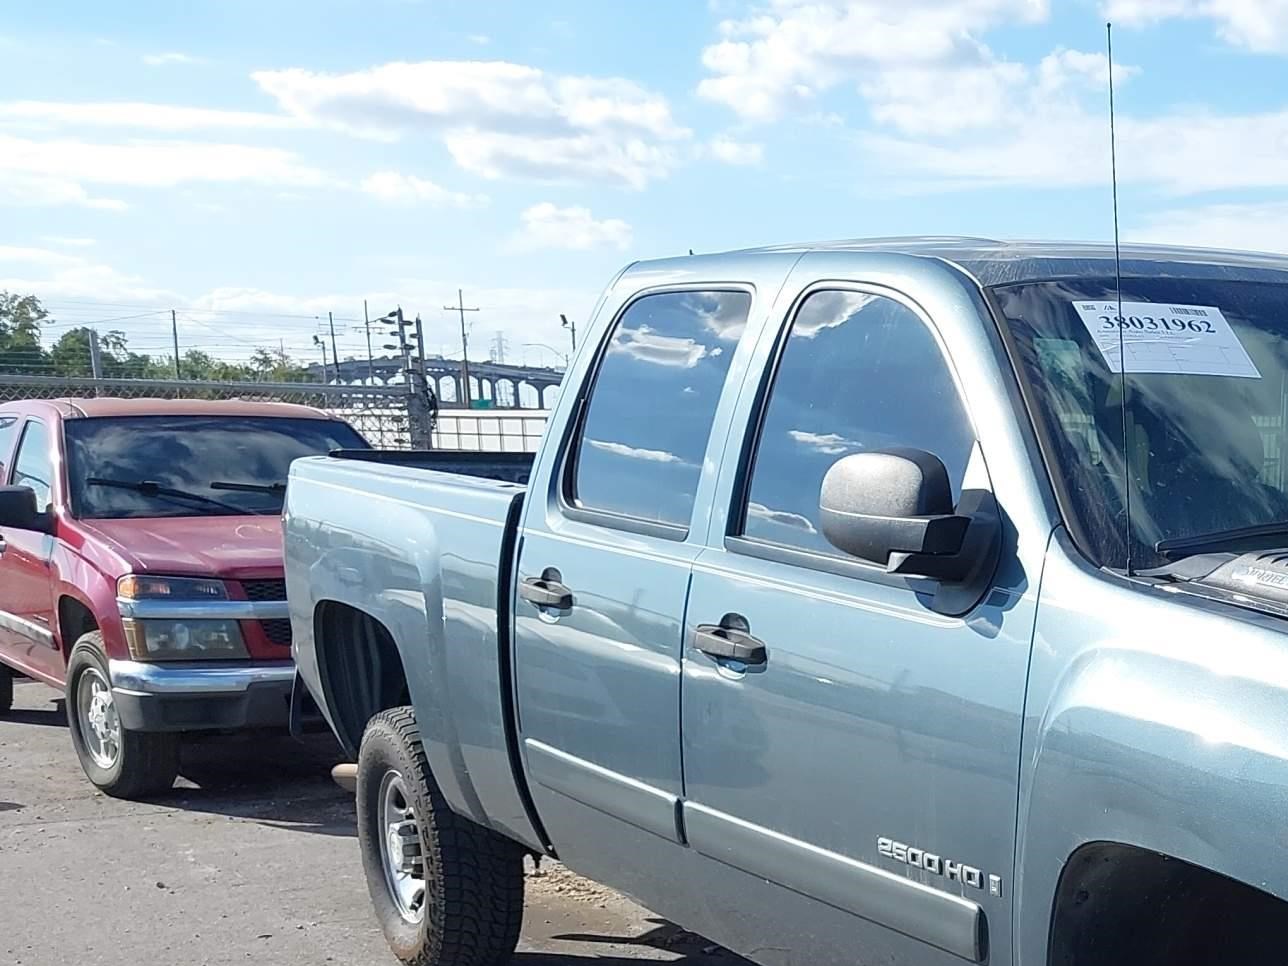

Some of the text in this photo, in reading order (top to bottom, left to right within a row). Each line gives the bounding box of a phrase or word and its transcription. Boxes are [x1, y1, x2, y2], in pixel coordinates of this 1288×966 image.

[1098, 315, 1216, 334] 38031962
[877, 837, 984, 889] 2500 HD
